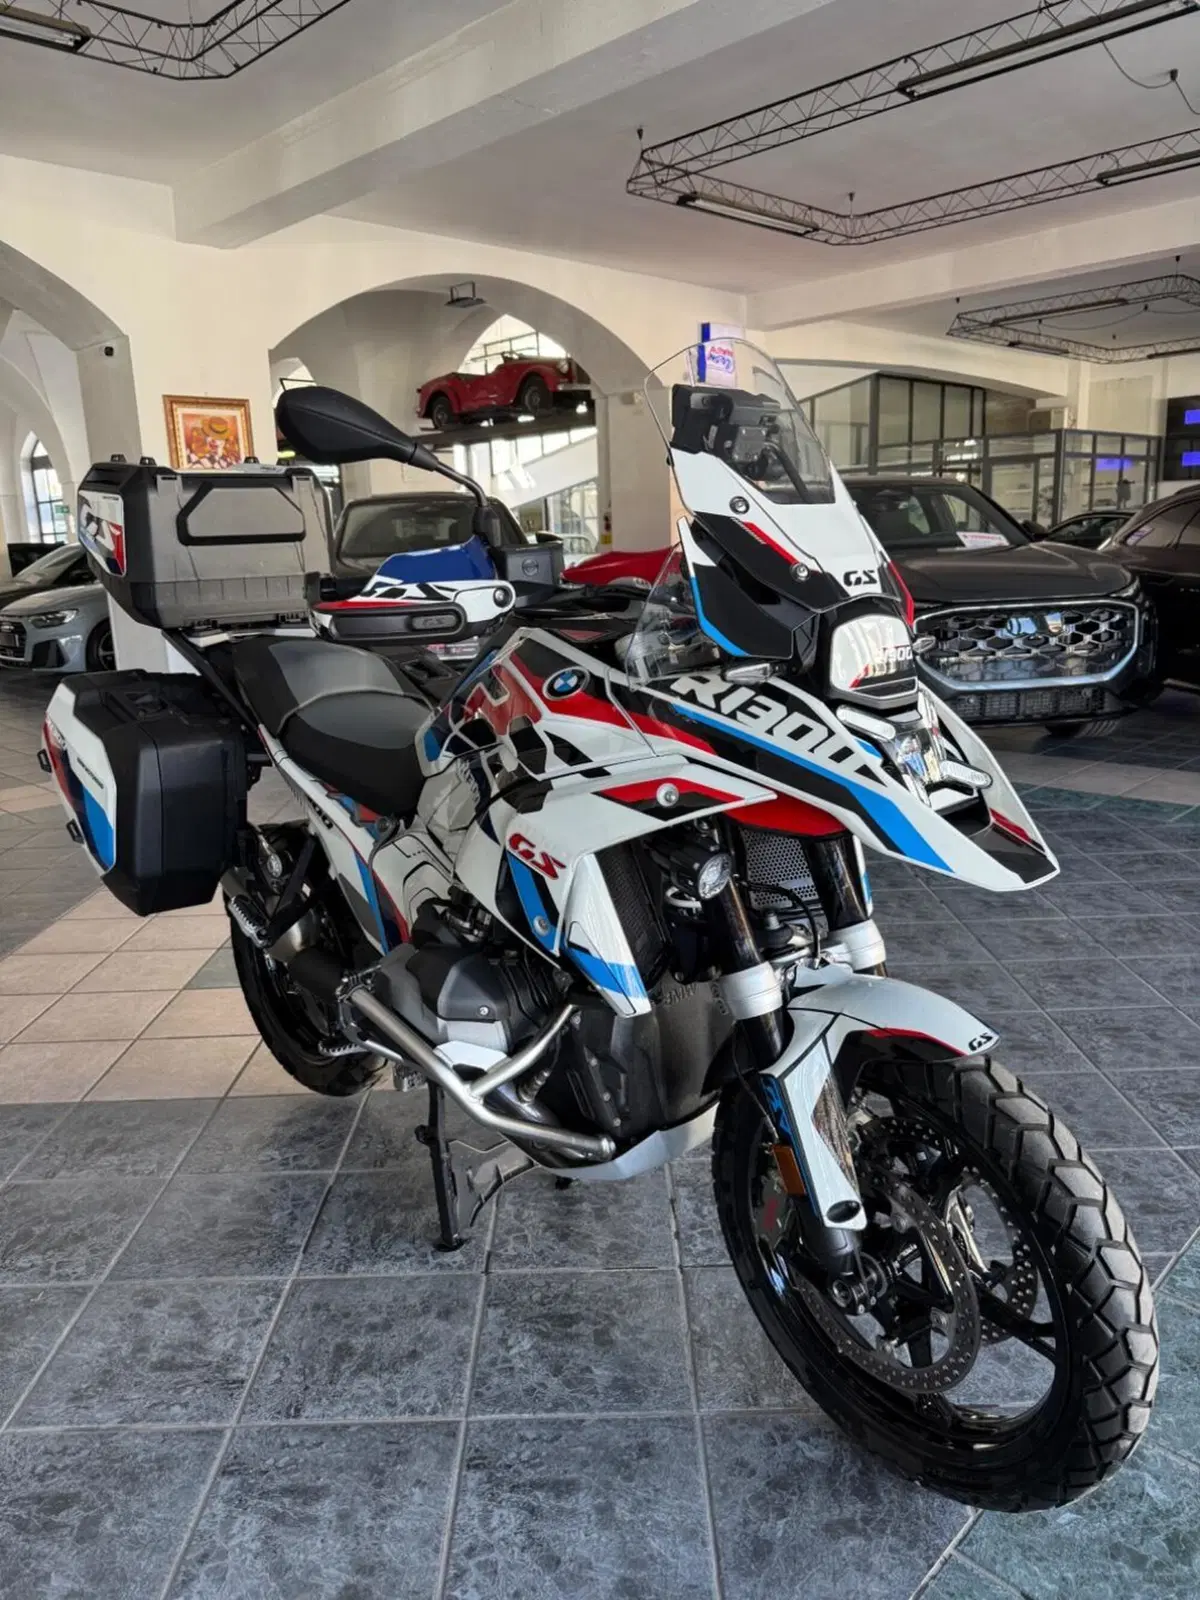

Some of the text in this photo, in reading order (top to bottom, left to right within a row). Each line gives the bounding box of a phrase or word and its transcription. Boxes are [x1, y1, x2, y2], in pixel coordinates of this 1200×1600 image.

[843, 570, 877, 586] GS
[509, 833, 567, 880] GS
[968, 1033, 994, 1052] GS
